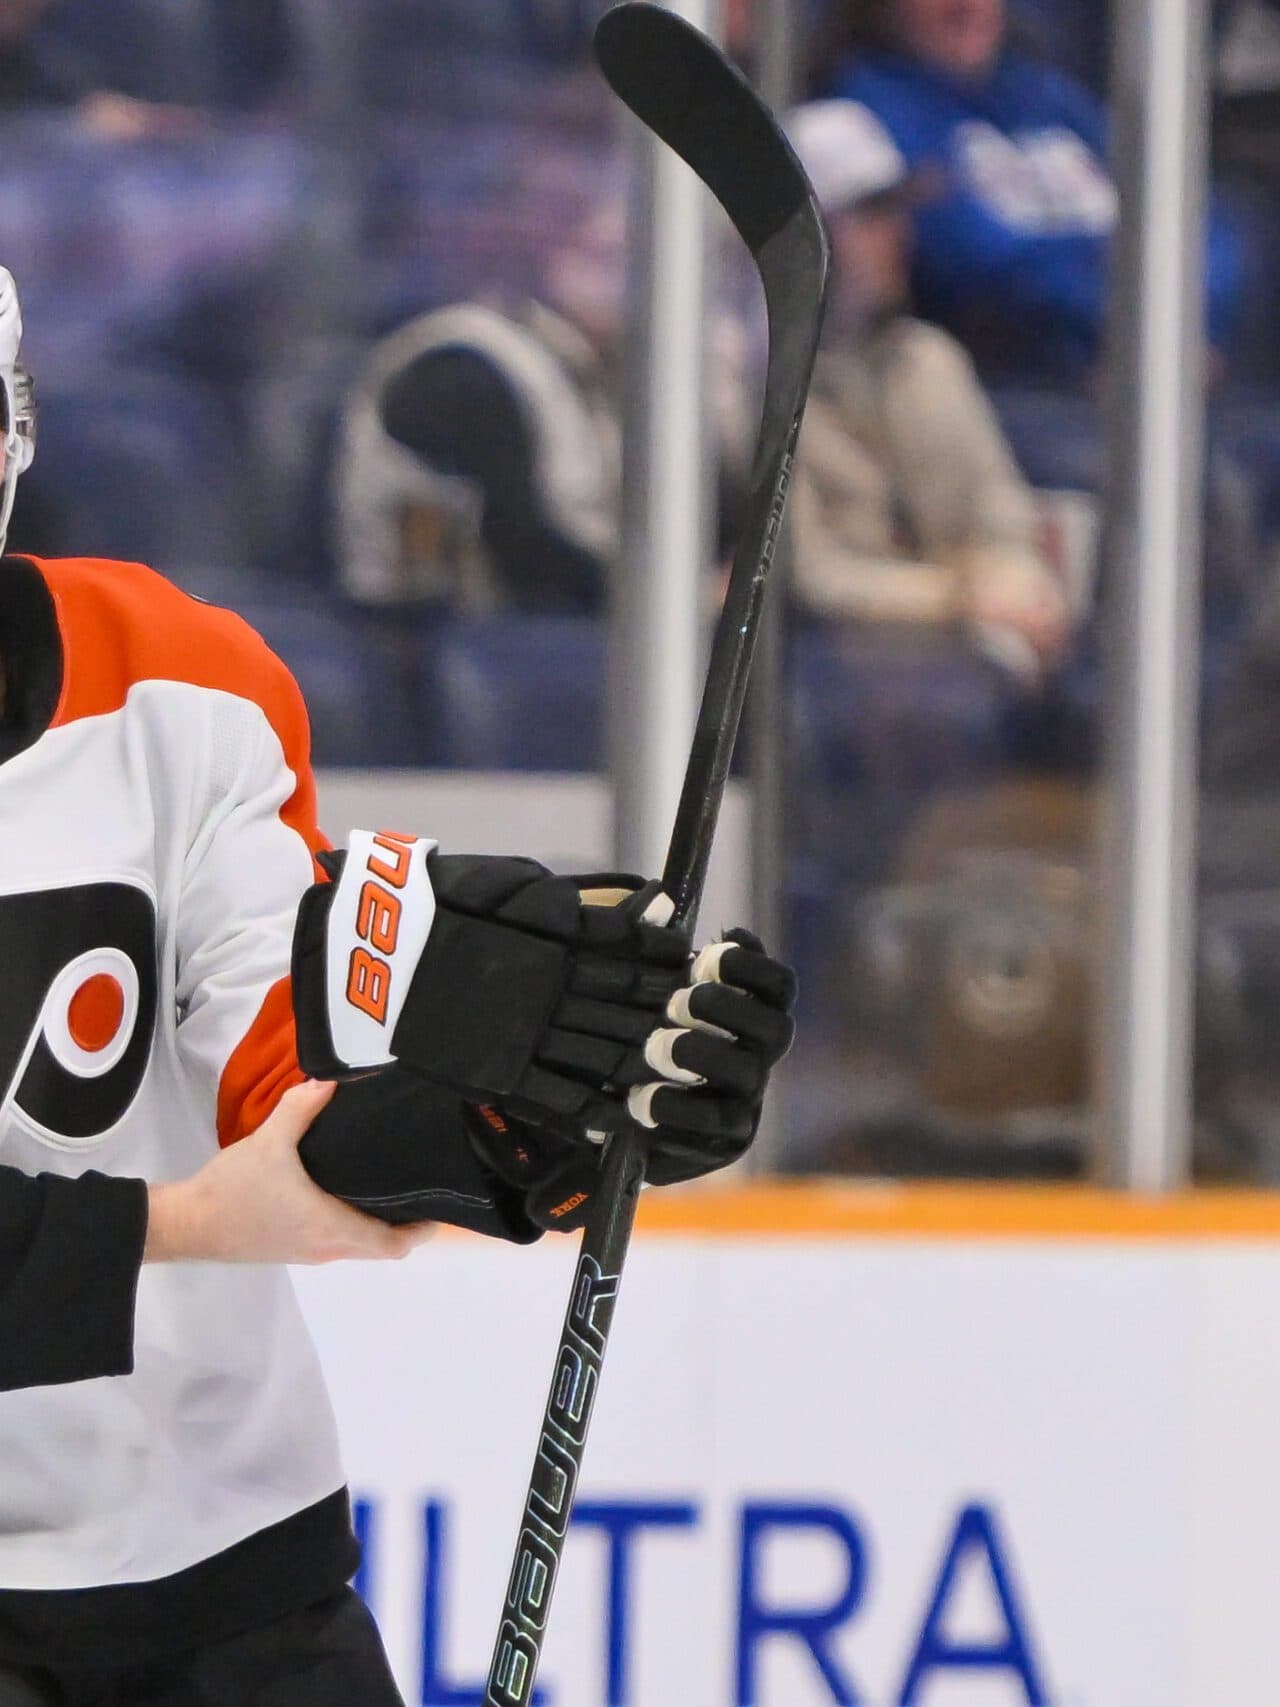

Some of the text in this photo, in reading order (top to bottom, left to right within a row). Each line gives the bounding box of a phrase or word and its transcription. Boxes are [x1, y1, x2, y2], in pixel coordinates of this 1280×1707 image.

[345, 831, 418, 1028] BAU
[549, 1192, 589, 1217] YORK
[353, 1493, 1052, 1707] LTRA
